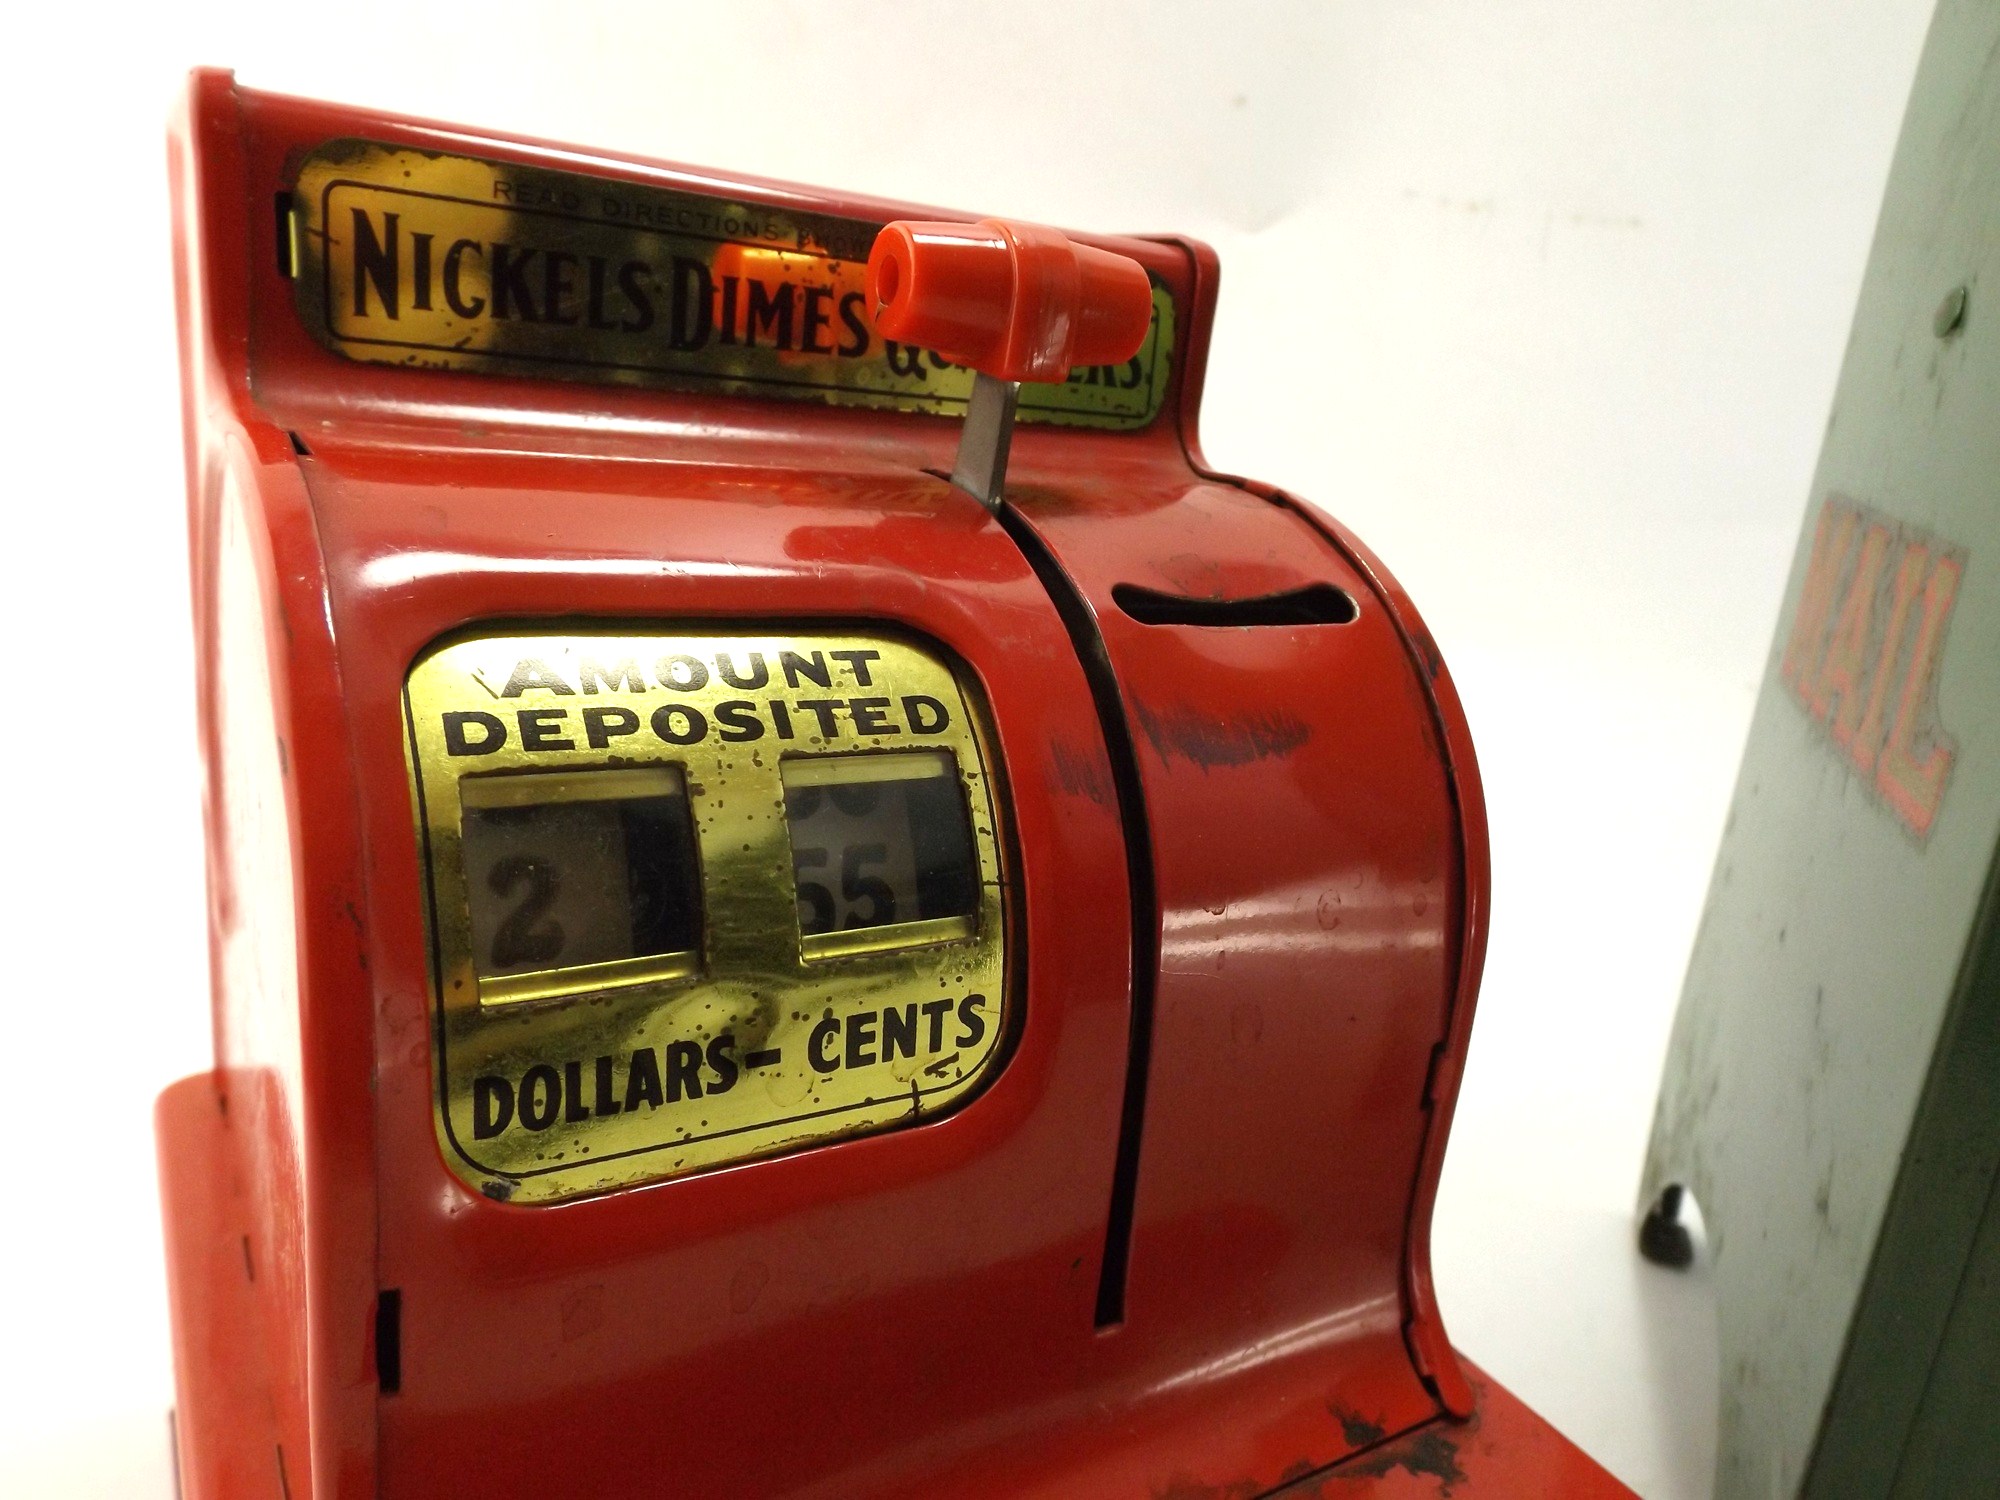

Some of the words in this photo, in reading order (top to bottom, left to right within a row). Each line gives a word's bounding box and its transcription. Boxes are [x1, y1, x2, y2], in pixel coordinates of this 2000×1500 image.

[493, 180, 581, 211] READ
[600, 199, 779, 239] DIRECTIONS
[351, 207, 654, 333] NICKELS
[670, 256, 869, 358] DIMES
[500, 650, 880, 698] AMOUNT
[441, 696, 951, 756] DEPOSITED
[487, 856, 564, 969] 2
[807, 994, 986, 1073] CENTS
